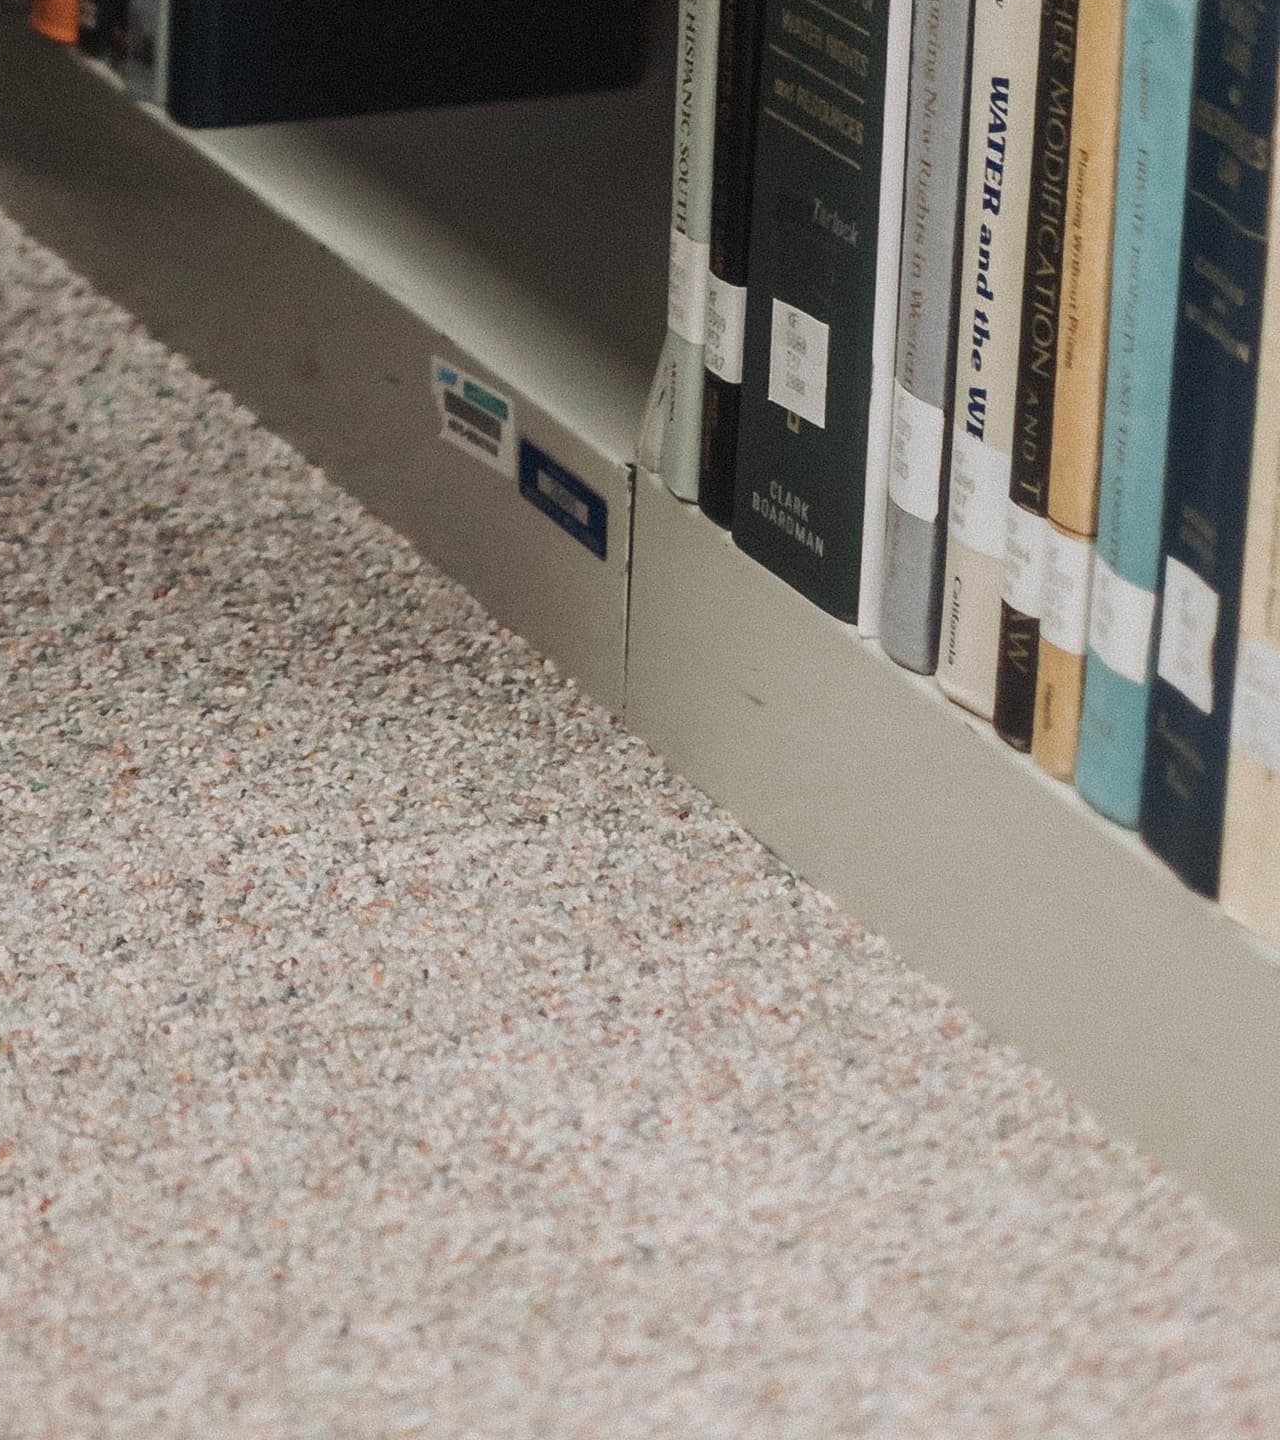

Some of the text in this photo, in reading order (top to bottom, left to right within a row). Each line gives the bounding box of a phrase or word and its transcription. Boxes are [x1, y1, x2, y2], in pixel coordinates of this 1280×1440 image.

[678, 13, 698, 138] HISPANIC
[920, 87, 940, 150] New
[981, 76, 1011, 215] WATER
[674, 145, 691, 236] SOUTH
[911, 157, 936, 246] Rights
[1071, 147, 1090, 230] Planning
[909, 252, 927, 279] in
[974, 223, 995, 302] and
[1029, 80, 1070, 379] MODIFICATION
[1067, 234, 1085, 311] Without
[968, 308, 992, 373] the
[1064, 313, 1080, 370] Prices
[1019, 387, 1041, 462] AND
[752, 490, 824, 558] BOARDMAN
[769, 479, 811, 523] CLARK
[946, 575, 964, 665] California
